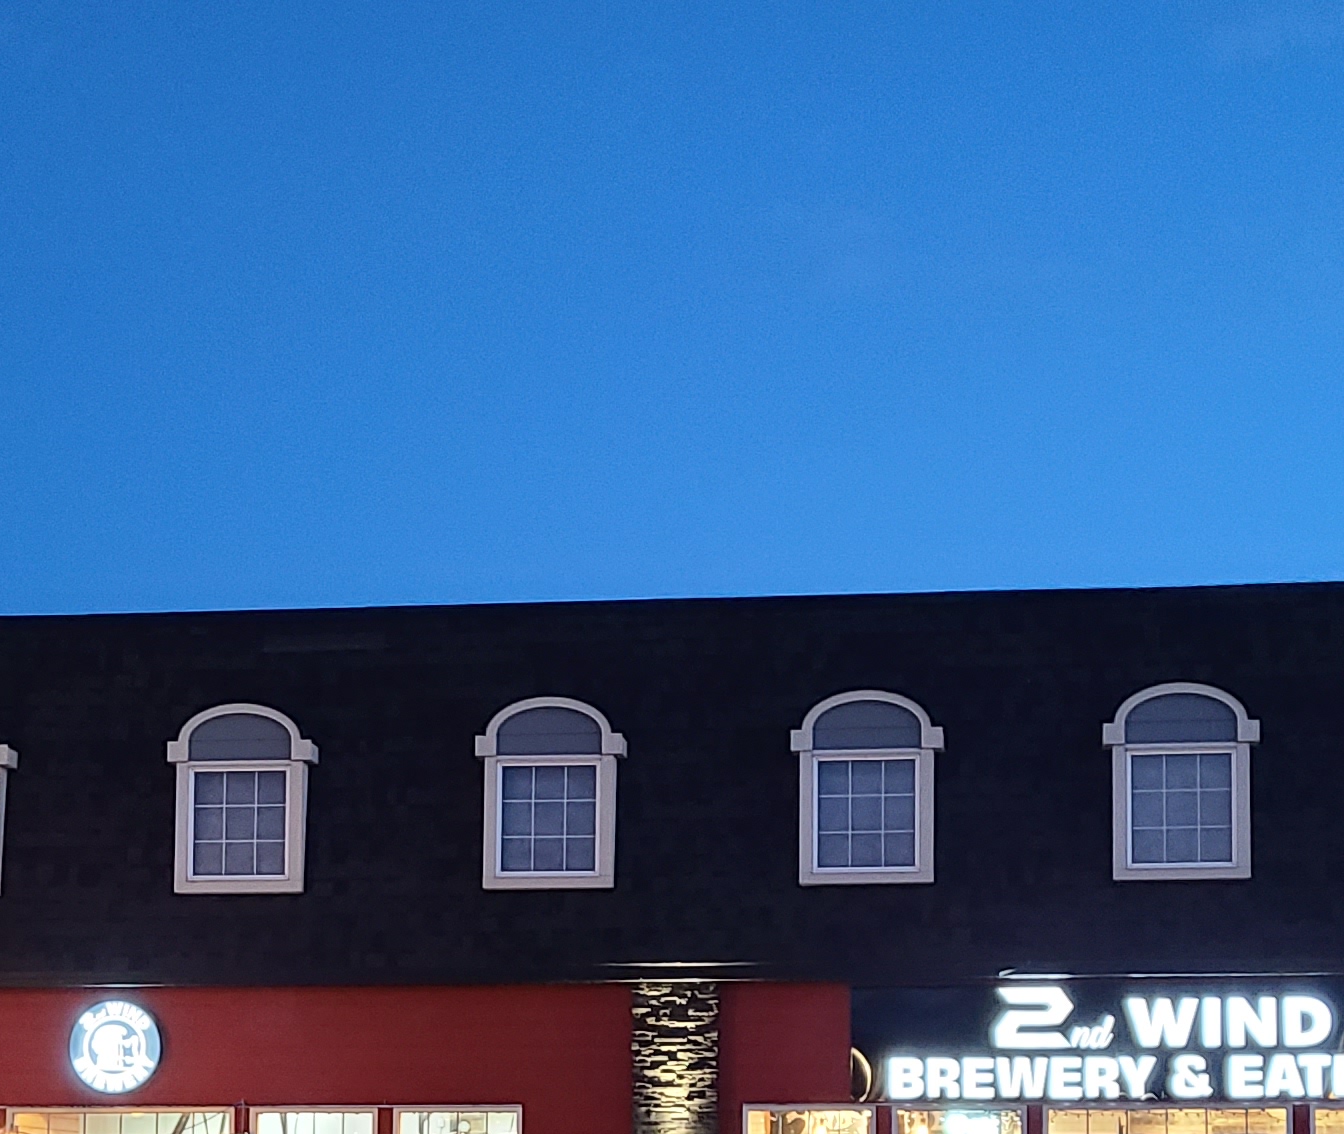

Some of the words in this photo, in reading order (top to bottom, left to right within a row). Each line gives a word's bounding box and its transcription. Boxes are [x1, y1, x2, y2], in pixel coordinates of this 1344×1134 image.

[994, 985, 1117, 1049] 2nd
[1127, 995, 1333, 1049] WIND
[888, 1055, 1157, 1100] BREWERY
[1170, 1053, 1214, 1100] &
